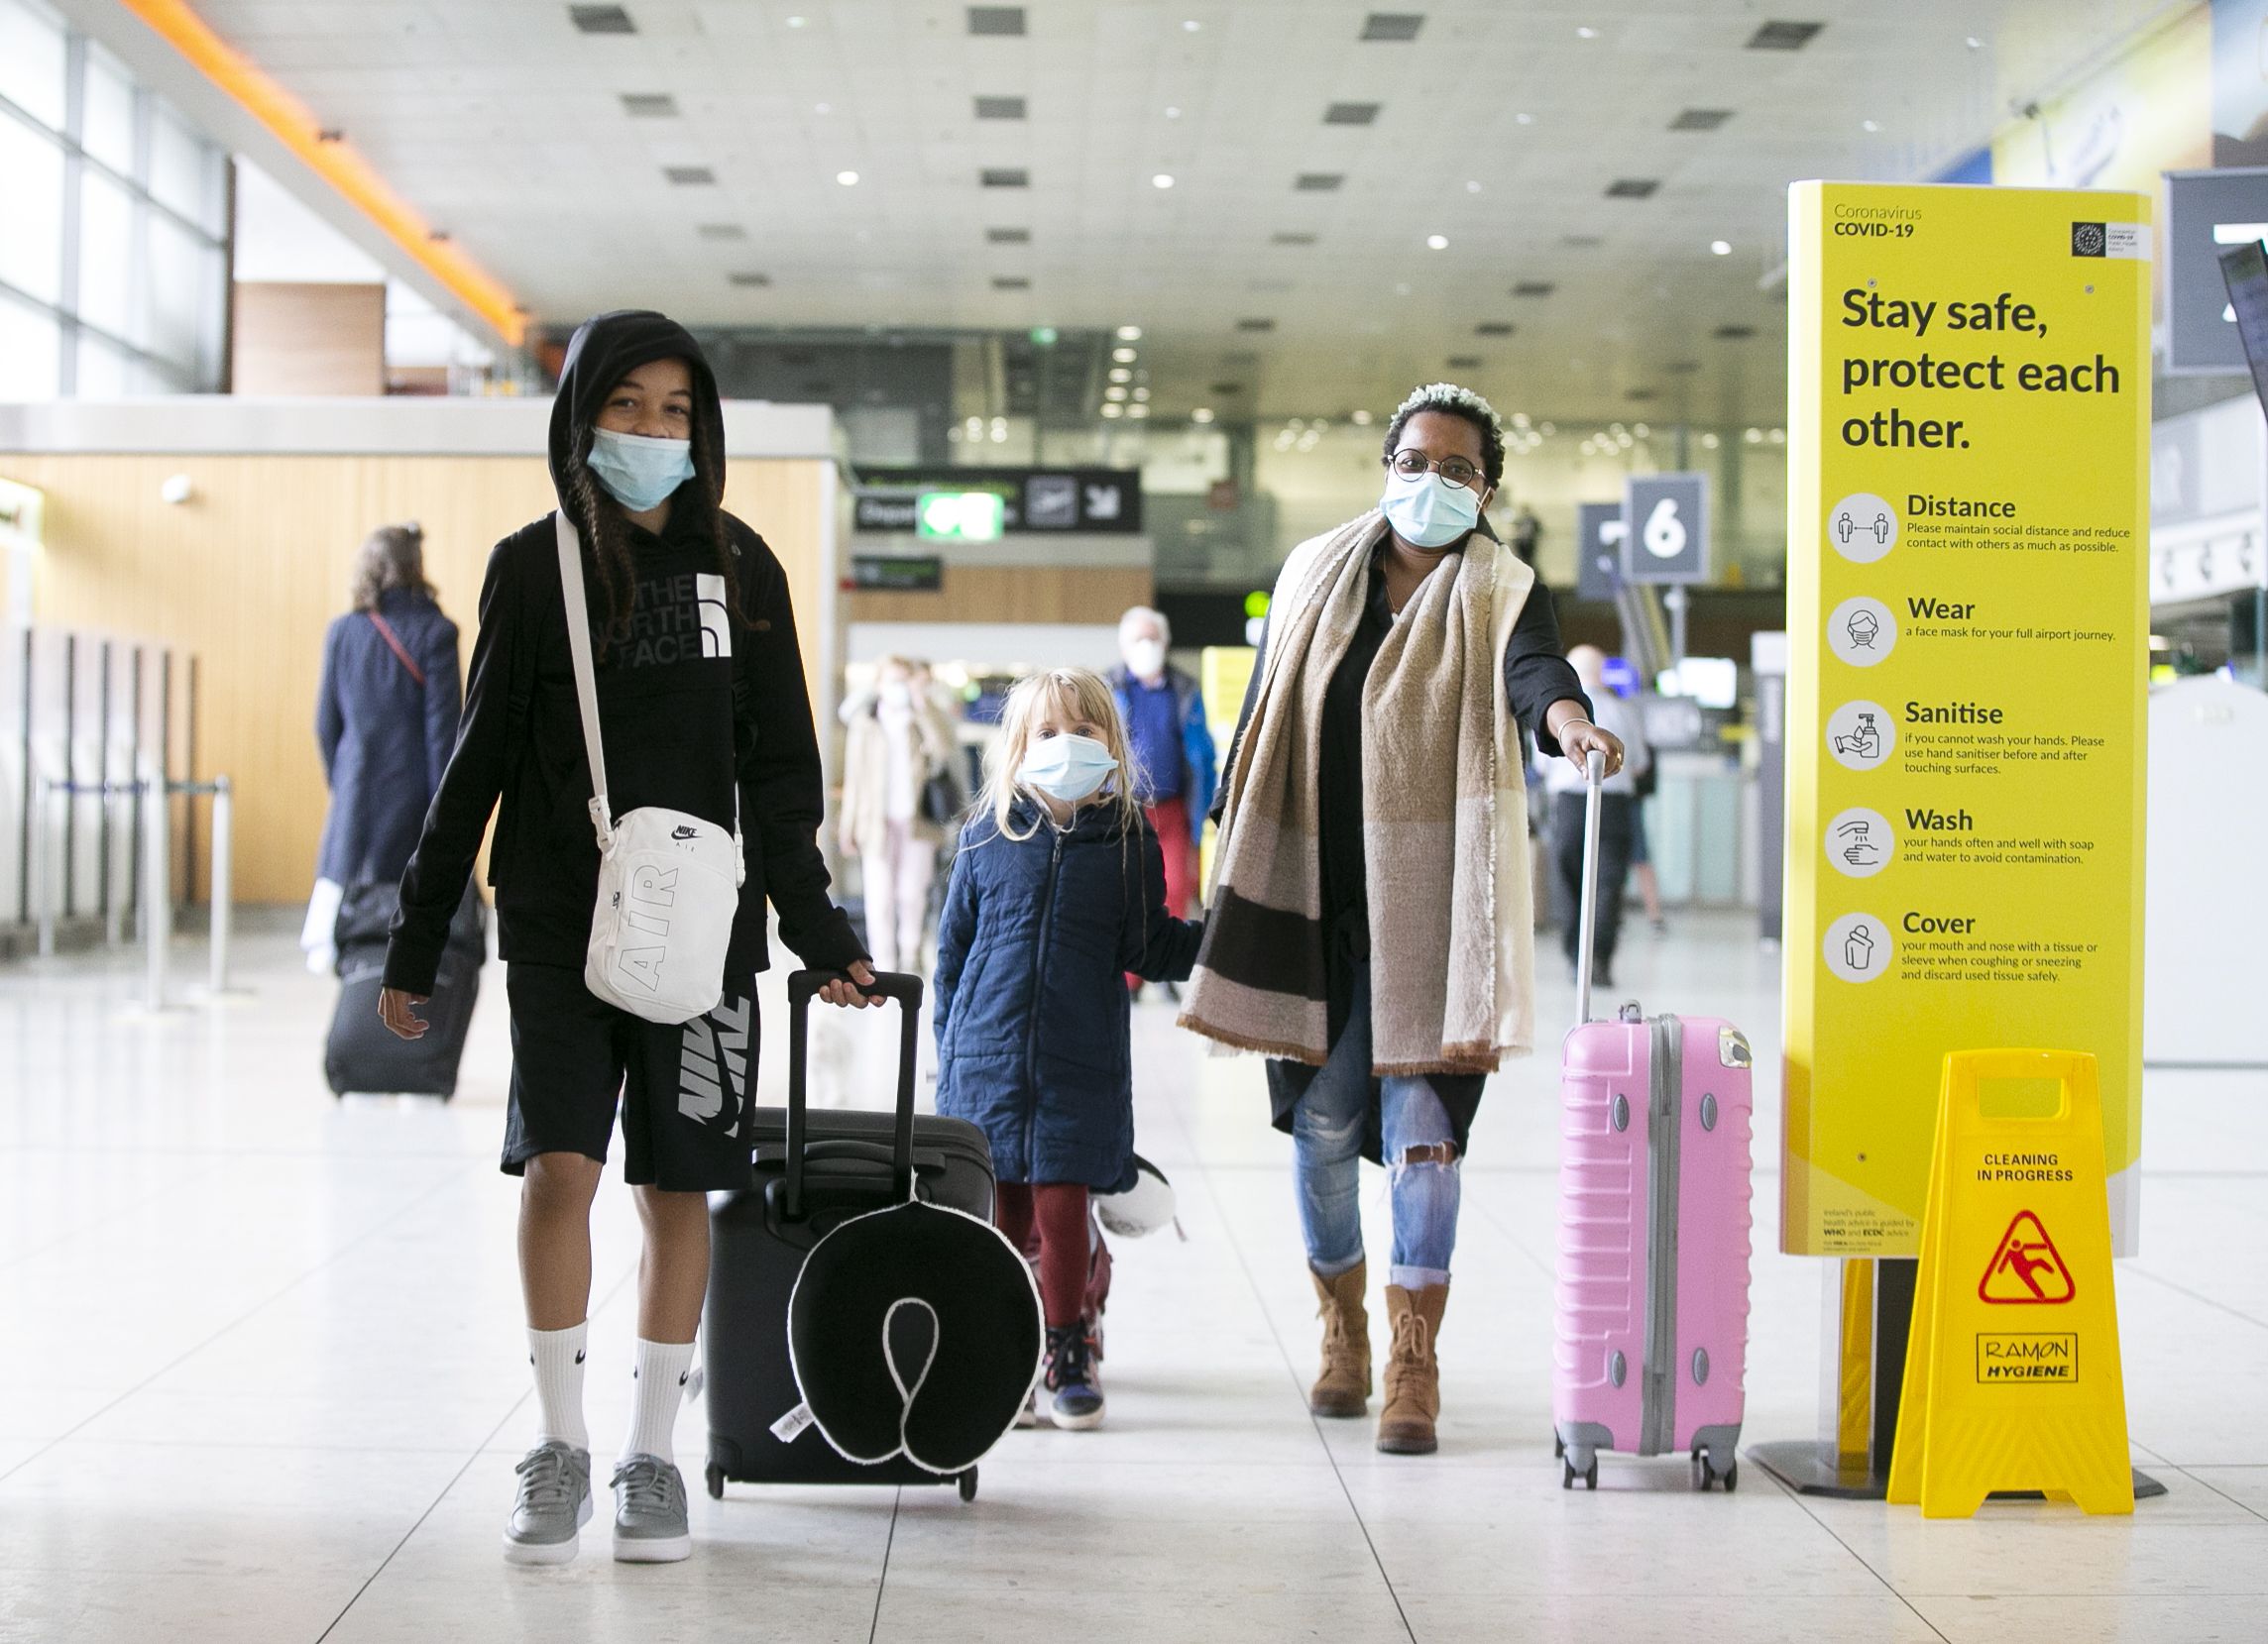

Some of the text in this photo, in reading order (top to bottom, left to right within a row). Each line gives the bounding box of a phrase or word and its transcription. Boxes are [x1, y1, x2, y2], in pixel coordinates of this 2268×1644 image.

[1835, 203, 1921, 220] Coronavirus
[1835, 222, 1914, 238] COVID-19
[1843, 288, 2047, 338] Stay safe,
[1844, 353, 2119, 394] protect each
[1842, 408, 1970, 448] other.
[1908, 494, 2016, 518] Distance
[1644, 498, 1686, 558] 6
[1907, 523, 2130, 538] Please maintain social distance and reduce
[1906, 538, 2118, 554] contact with others as much as possible.
[634, 574, 693, 610] THE
[1908, 598, 1975, 619] Wear
[1915, 626, 1937, 636] face
[1941, 626, 1968, 637] mask
[1972, 627, 1986, 638] for
[1989, 629, 2013, 640] your
[2016, 627, 2033, 638] full
[2036, 628, 2071, 641] airport
[2073, 629, 2115, 642] journey.
[619, 632, 700, 669] FACE
[1905, 702, 2003, 724] Sanitise
[1905, 732, 2104, 747] if you cannot wash your hands. Please
[1905, 747, 2088, 761] use hand sanitiser before and after
[1905, 762, 2000, 775] touching surfaces.
[1905, 809, 1973, 830] Wash
[676, 824, 697, 837] NIKE
[1903, 836, 2094, 851] your hands often and well with soap
[1903, 851, 2083, 864] and water to avoid contamination.
[619, 865, 678, 991] AIR
[1903, 912, 1976, 933] Cover
[1901, 942, 1926, 953] your
[1929, 940, 1964, 951] mouth
[1967, 940, 1986, 951] and
[2018, 941, 2041, 952] with
[2053, 941, 2084, 952] tissue
[2087, 944, 2098, 953] or
[1901, 954, 2082, 969] sleeve when coughing or sneezing
[1901, 969, 2060, 983] and discard used tissue safely.
[1984, 1154, 2058, 1165] CLEANING
[1977, 1170, 2074, 1181] IN PROGRESS
[1986, 1338, 2069, 1360] RAMON
[1987, 1366, 2070, 1377] HYGIENE
